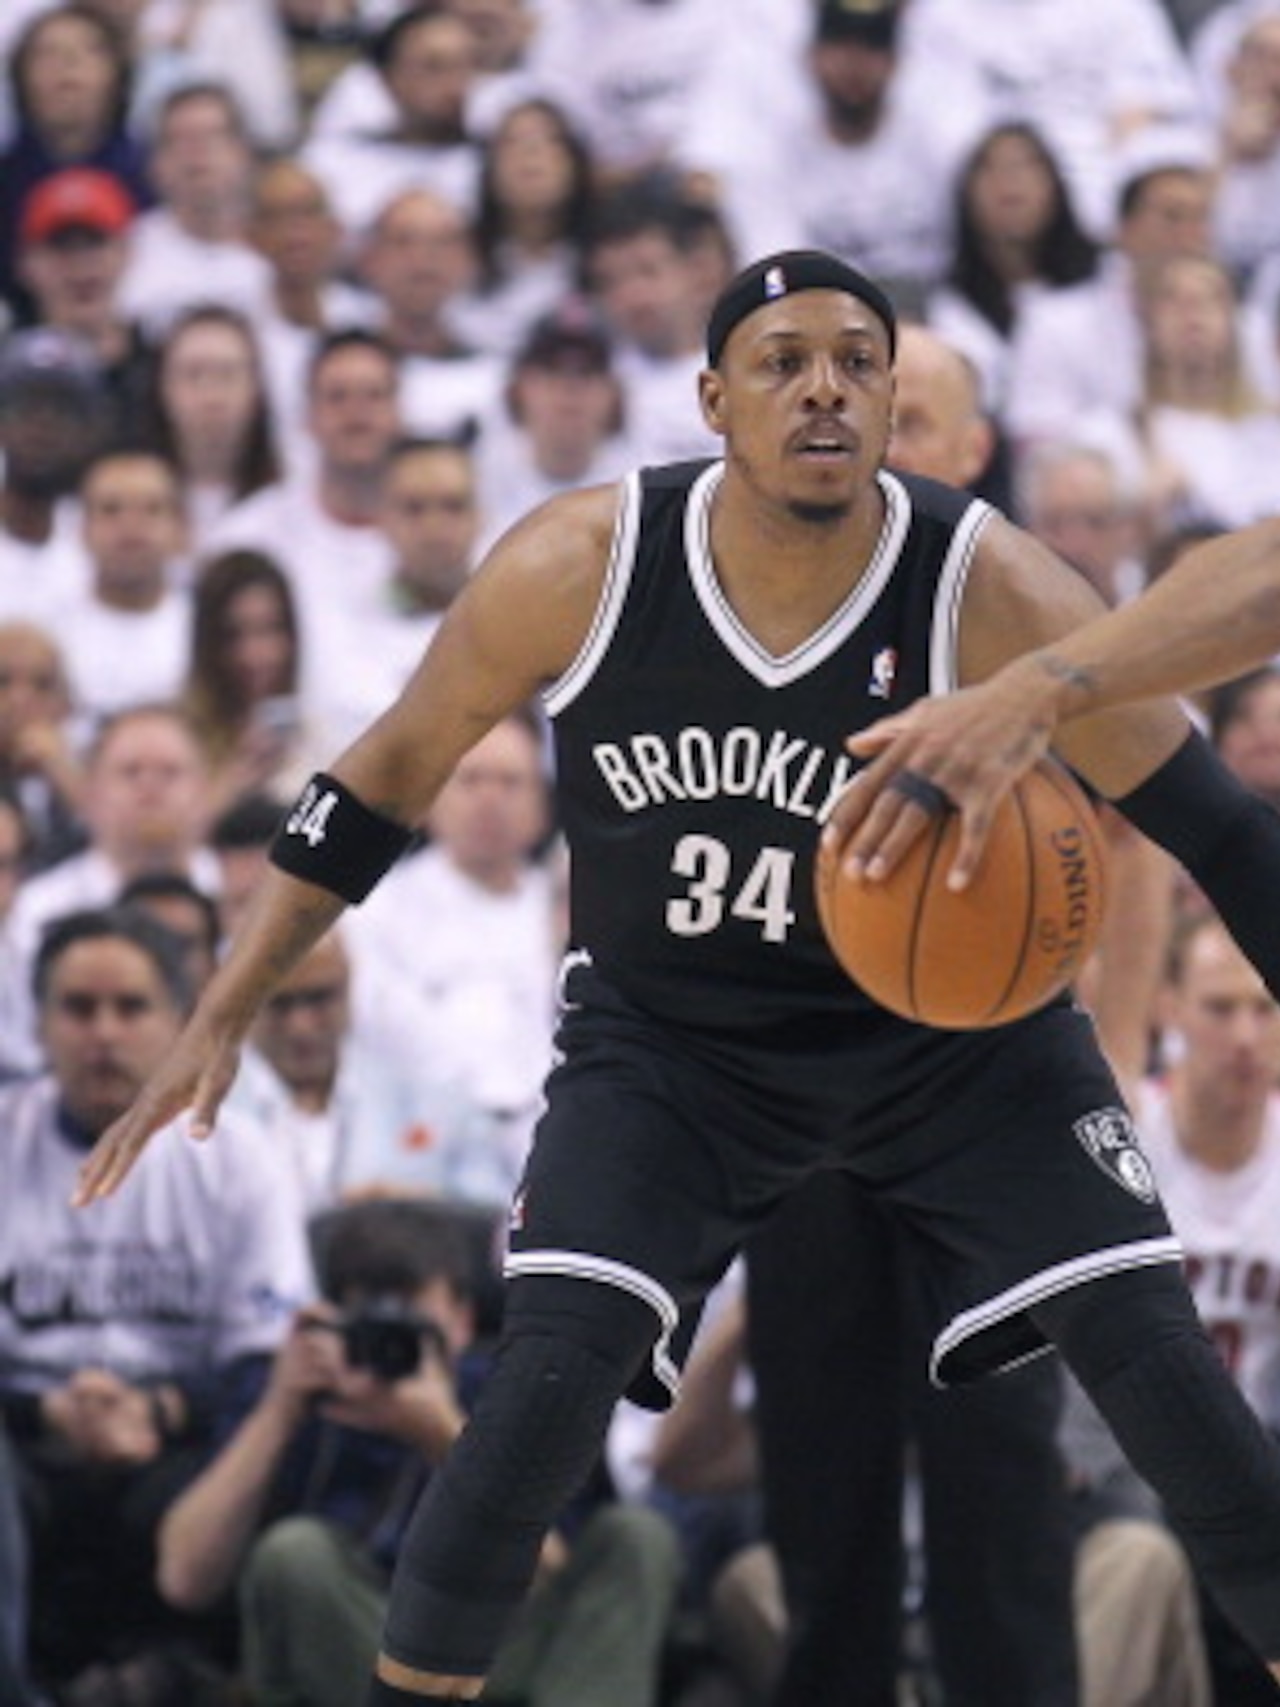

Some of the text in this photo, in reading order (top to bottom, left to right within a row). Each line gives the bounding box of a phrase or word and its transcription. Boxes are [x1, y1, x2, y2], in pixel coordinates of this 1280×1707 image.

[286, 783, 339, 847] 34
[592, 726, 851, 825] BROOKLY
[666, 834, 796, 943] 34
